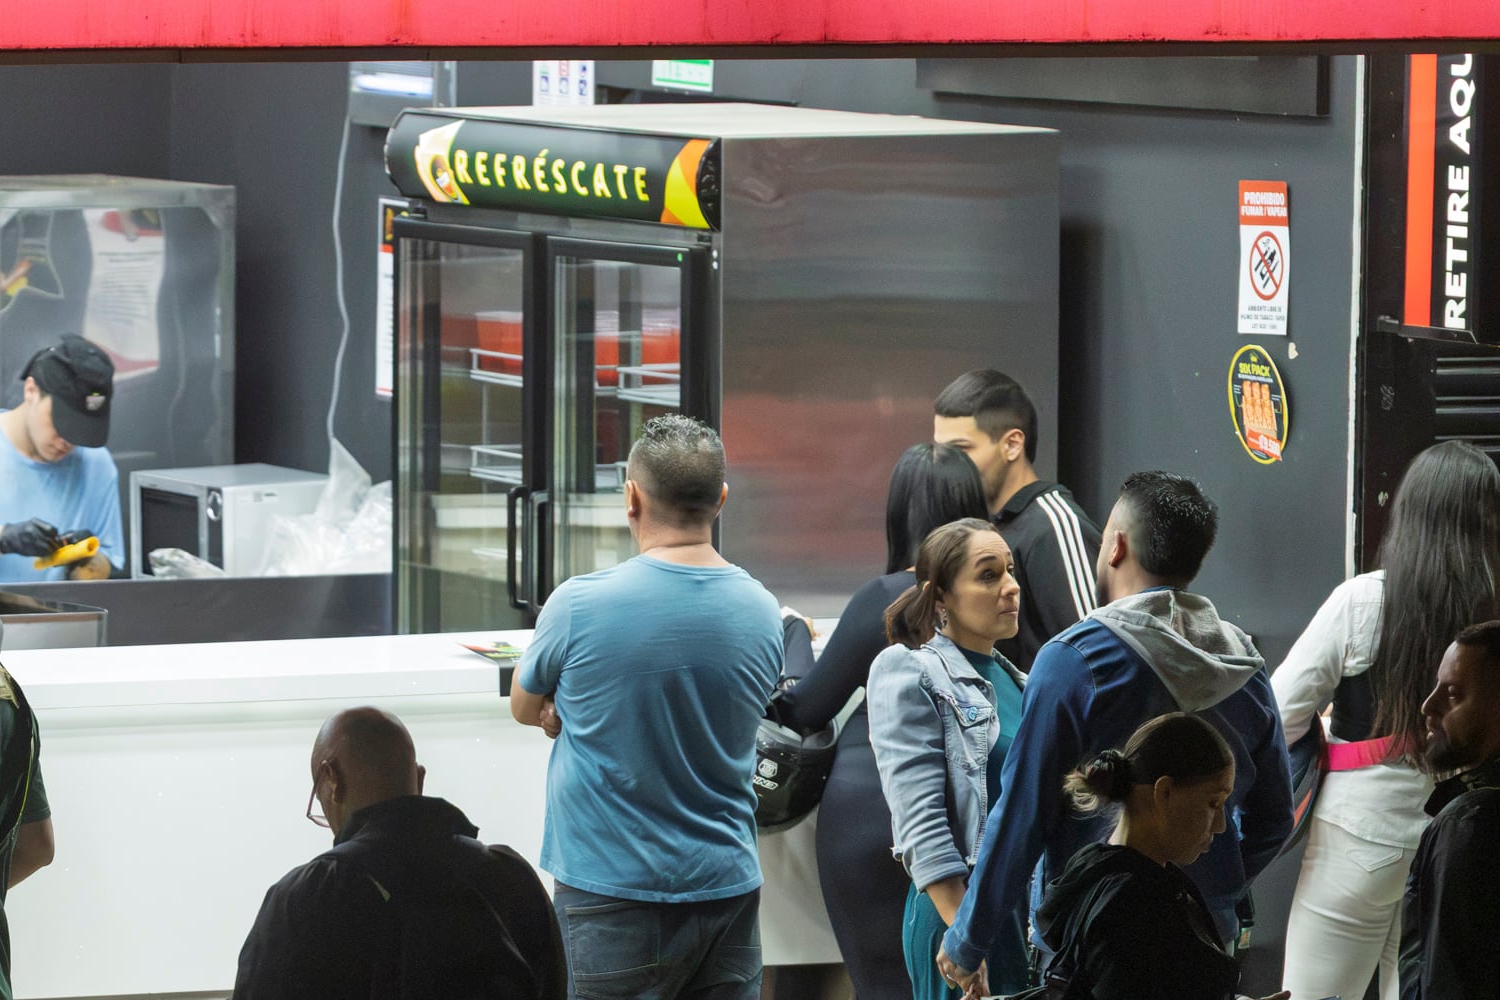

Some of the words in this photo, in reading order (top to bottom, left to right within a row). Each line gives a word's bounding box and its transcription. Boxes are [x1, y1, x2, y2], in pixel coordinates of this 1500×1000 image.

[454, 148, 650, 201] REFRÉSCATE
[1244, 192, 1284, 205] PROHIBIDO
[1444, 164, 1470, 330] RETIRE
[1239, 362, 1252, 374] SIX
[1252, 365, 1272, 378] PACK
